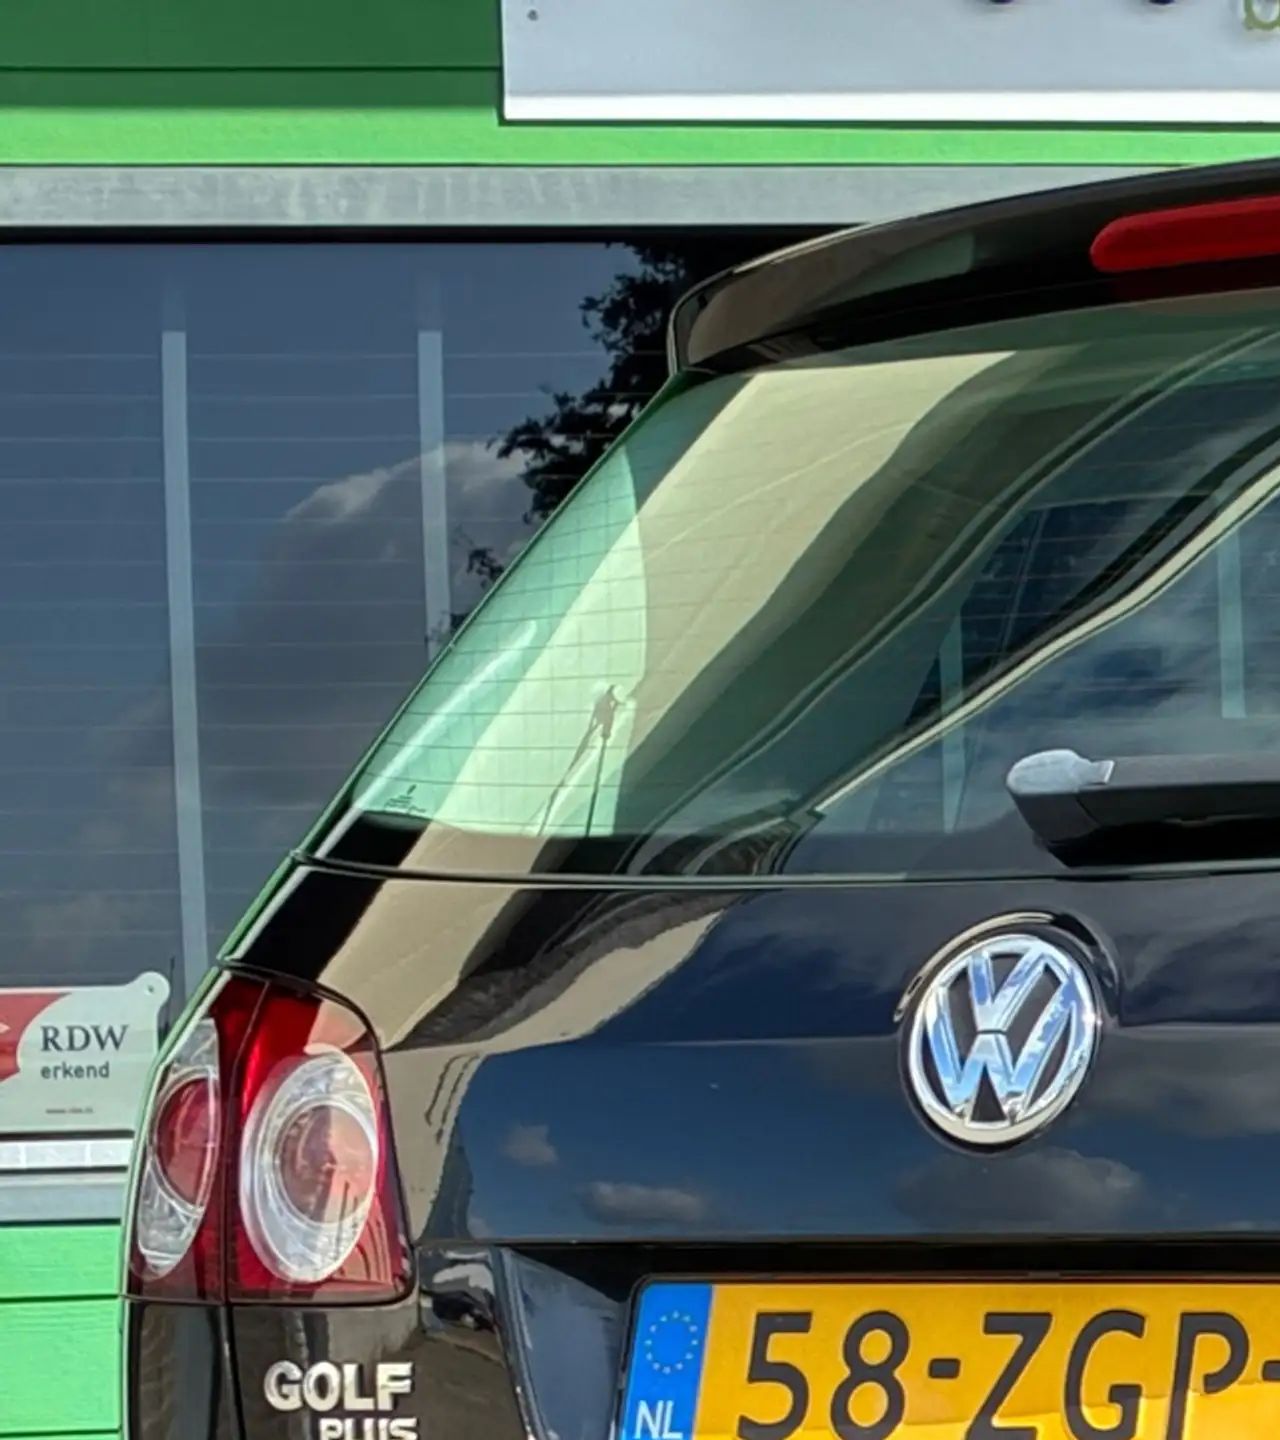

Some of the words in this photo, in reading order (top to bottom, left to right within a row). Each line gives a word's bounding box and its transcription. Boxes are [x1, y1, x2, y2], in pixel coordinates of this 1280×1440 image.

[40, 1024, 129, 1052] RDW
[40, 1061, 110, 1080] erkend
[263, 1360, 413, 1411] GOLF
[633, 1399, 684, 1440] NL
